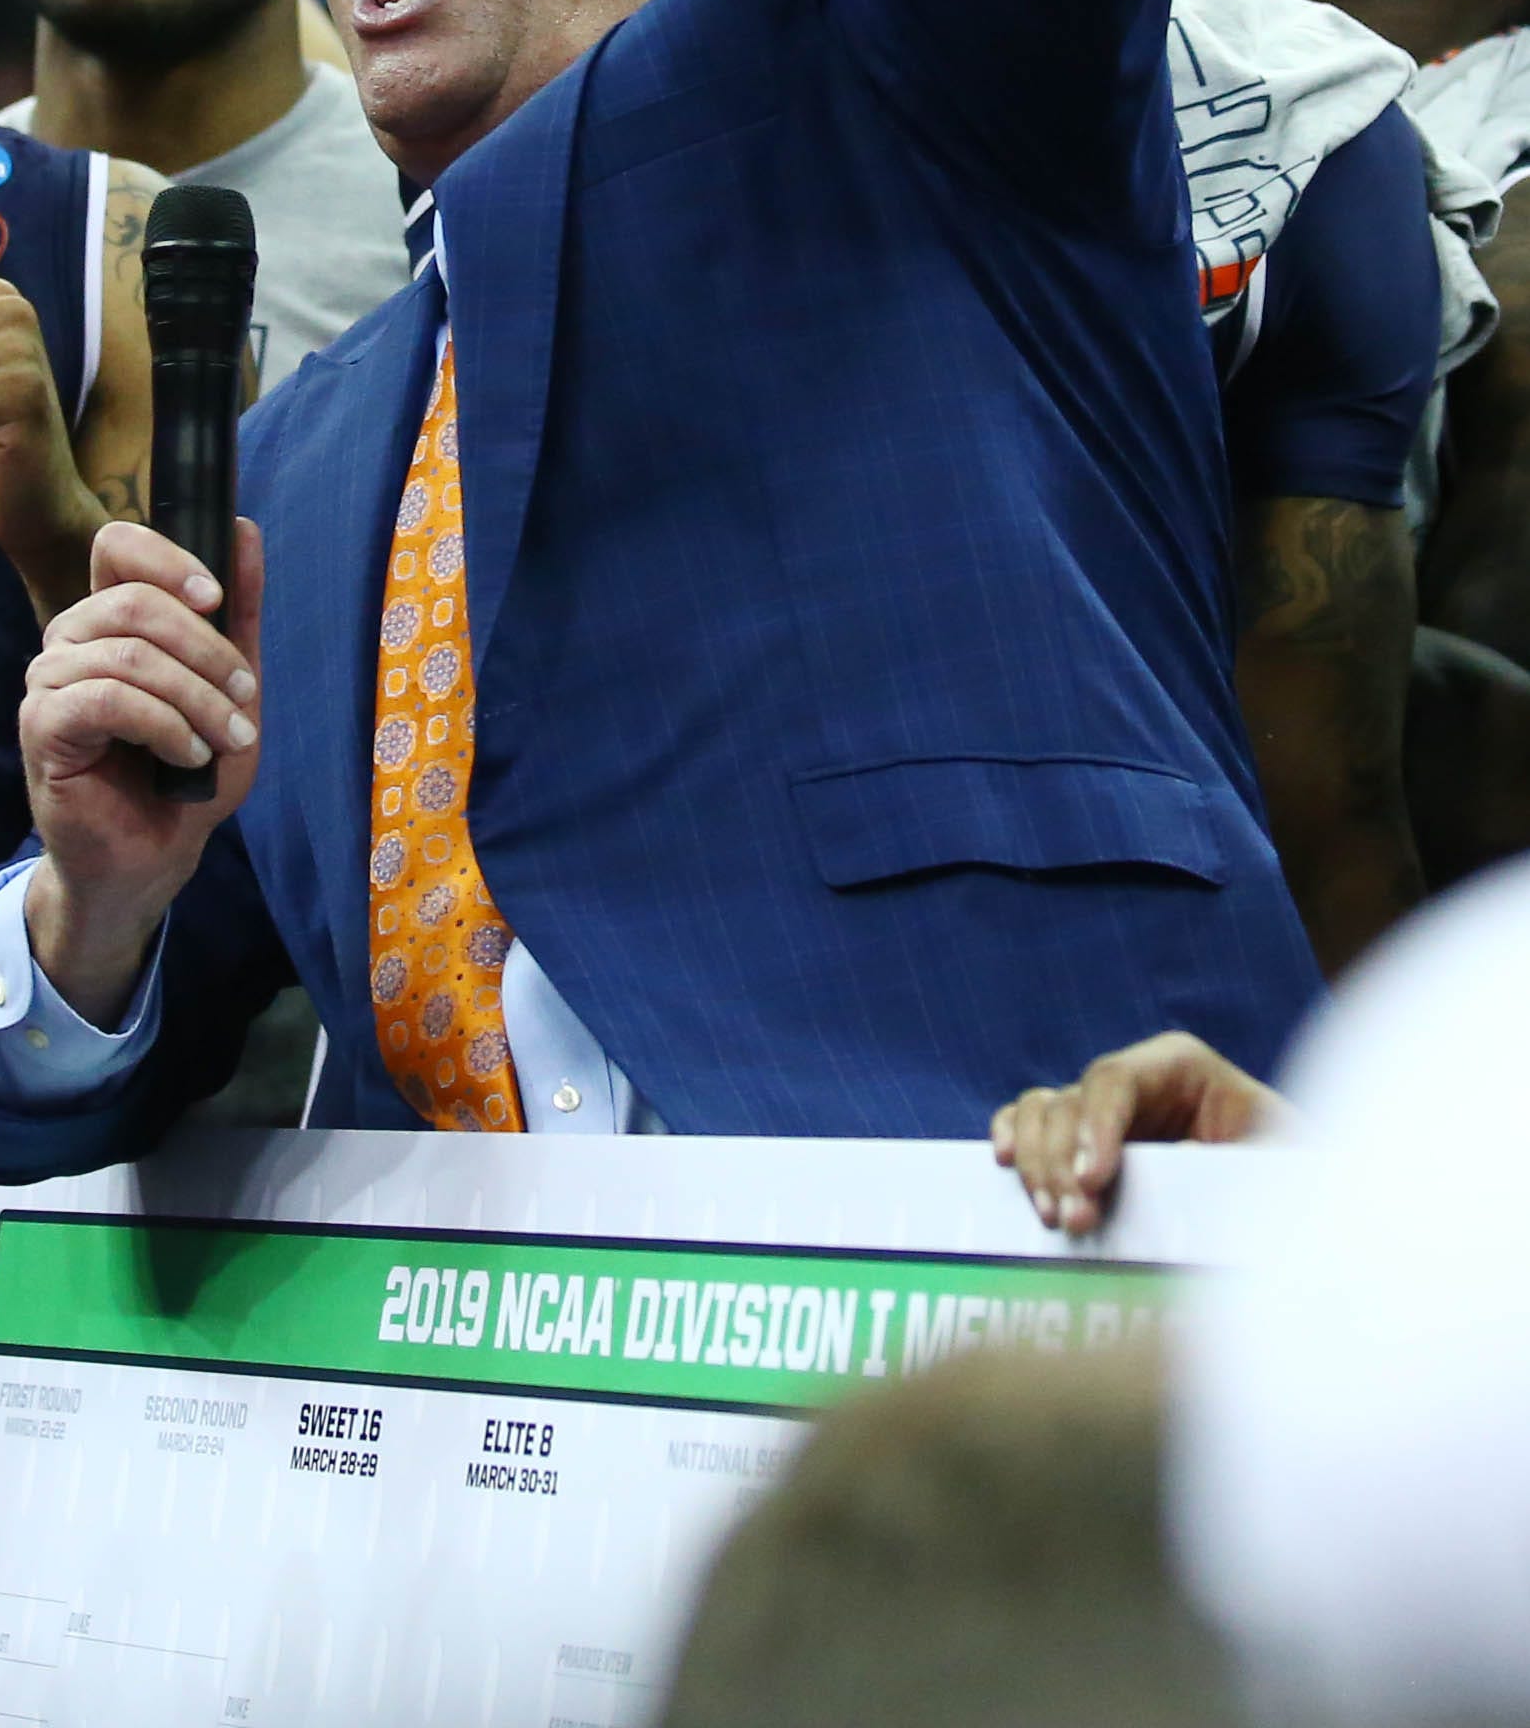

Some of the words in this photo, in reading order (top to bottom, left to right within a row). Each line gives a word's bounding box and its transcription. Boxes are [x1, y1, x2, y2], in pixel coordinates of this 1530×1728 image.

[378, 1265, 491, 1348] 2019
[623, 1278, 860, 1374] DIVISION
[861, 1289, 897, 1377] I
[37, 1385, 83, 1415] ROUND
[143, 1395, 199, 1426] SECOND
[199, 1399, 249, 1429] ROUND
[298, 1403, 359, 1440] SWEET
[359, 1408, 383, 1442] 16
[482, 1419, 537, 1457] ELITE
[539, 1424, 554, 1458] 8
[157, 1431, 194, 1453] MARCH
[194, 1434, 225, 1456] 23-24
[666, 1440, 750, 1474] NATIONAL
[290, 1446, 338, 1474] MARCH
[339, 1450, 378, 1478] 28-29
[466, 1463, 517, 1491] MARCH
[519, 1468, 558, 1496] 30-31
